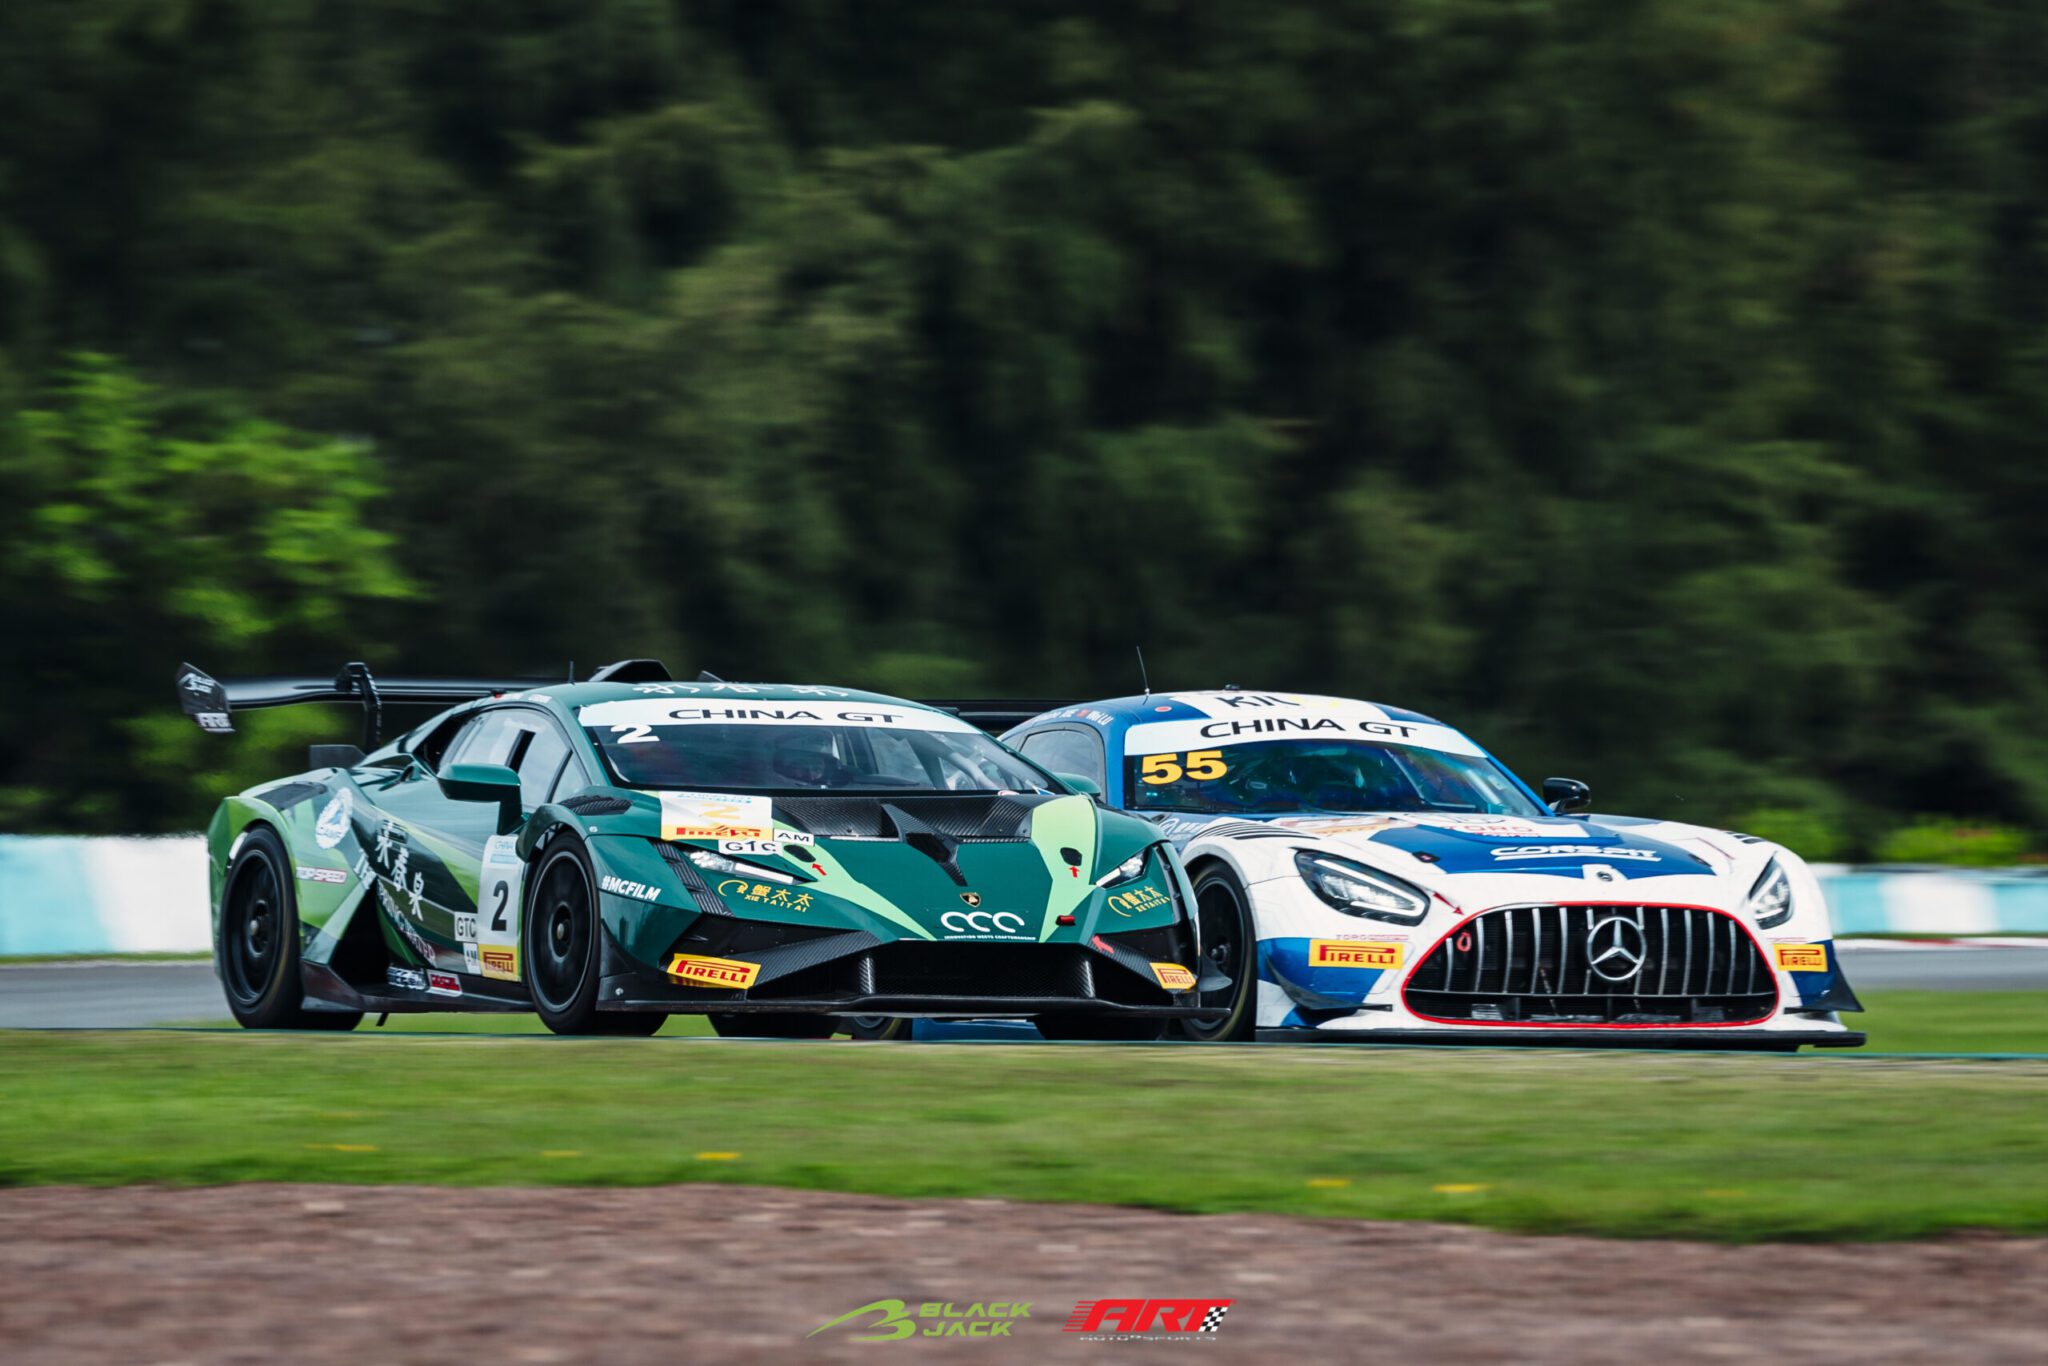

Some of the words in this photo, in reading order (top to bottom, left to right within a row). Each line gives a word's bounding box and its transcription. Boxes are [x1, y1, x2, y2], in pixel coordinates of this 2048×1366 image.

[669, 708, 822, 720] CHINA
[837, 711, 903, 723] GT
[610, 723, 660, 744] 2
[1201, 718, 1346, 738] CHINA
[1359, 721, 1418, 738] GT
[1141, 750, 1228, 785] 55
[778, 832, 810, 842] AM
[601, 875, 661, 901] #MCFILM
[752, 884, 814, 908] 蟹太太
[491, 880, 508, 931] 2
[456, 917, 477, 938] GTC
[483, 951, 514, 973] PIRELLI
[1319, 944, 1396, 965] PIRELLI
[1780, 949, 1822, 966] PIRELLI
[676, 960, 752, 983] PIRELLI
[1157, 968, 1194, 984] PIRELLI
